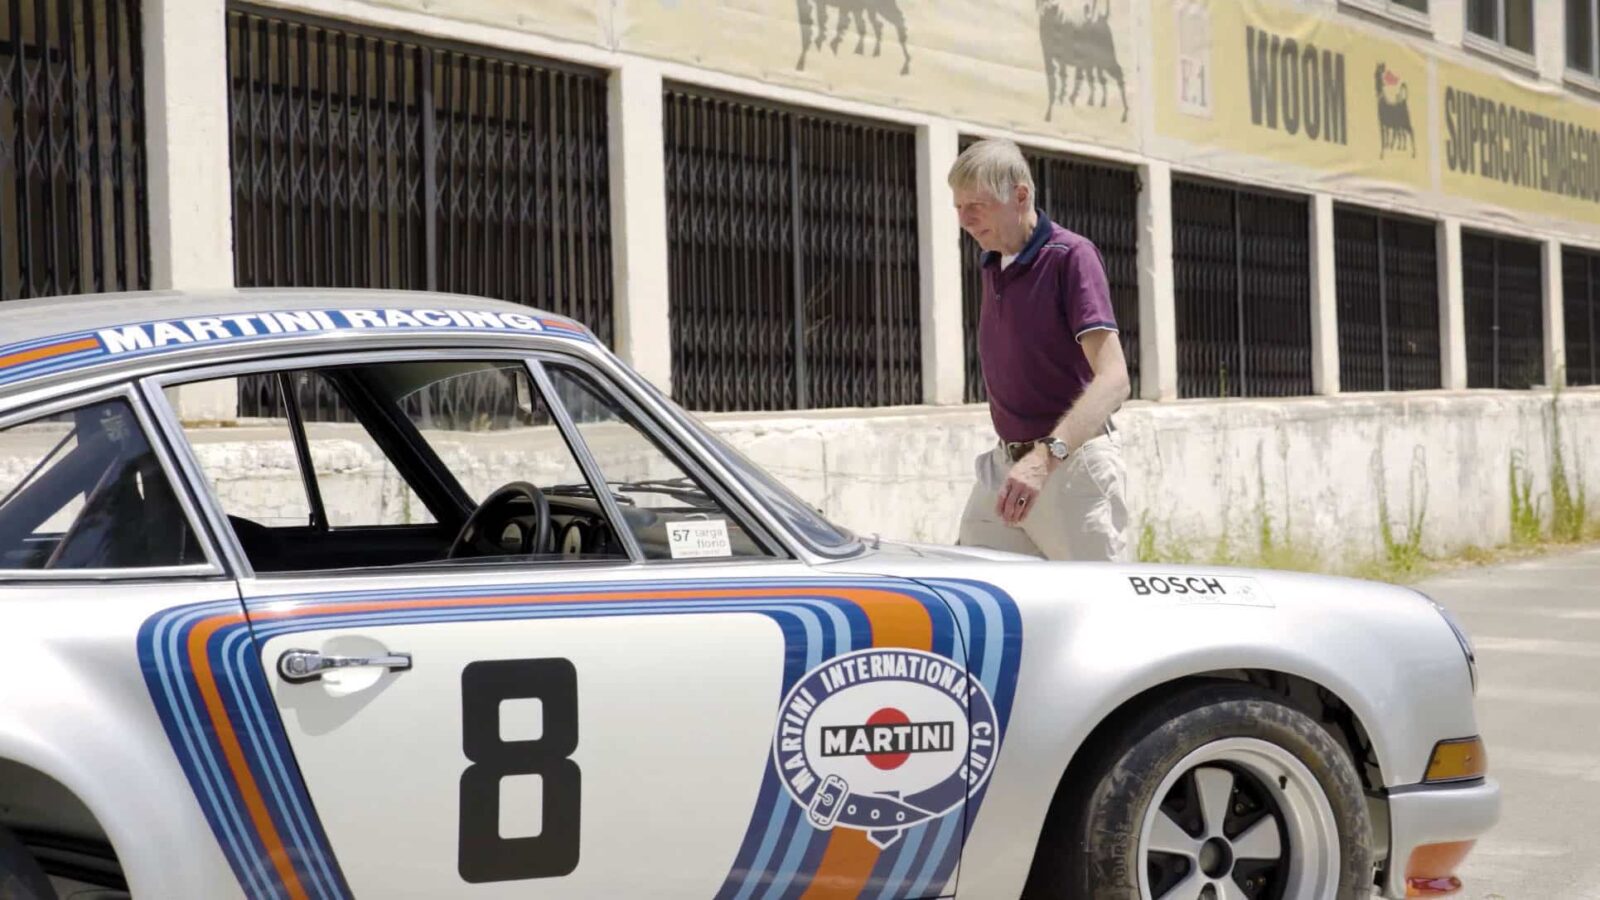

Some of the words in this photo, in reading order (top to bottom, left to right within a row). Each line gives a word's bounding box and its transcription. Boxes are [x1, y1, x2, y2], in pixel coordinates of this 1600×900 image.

[1246, 25, 1348, 146] WOOM
[101, 310, 337, 354] MARTINI
[339, 308, 540, 331] RACING
[672, 529, 690, 542] 57
[1128, 576, 1226, 595] BOSCH
[781, 687, 816, 795] MARTINI
[820, 654, 978, 707] INTERNATIONAL
[959, 721, 992, 785] CLUB
[823, 724, 950, 754] MARTINI
[458, 657, 581, 883] 8
